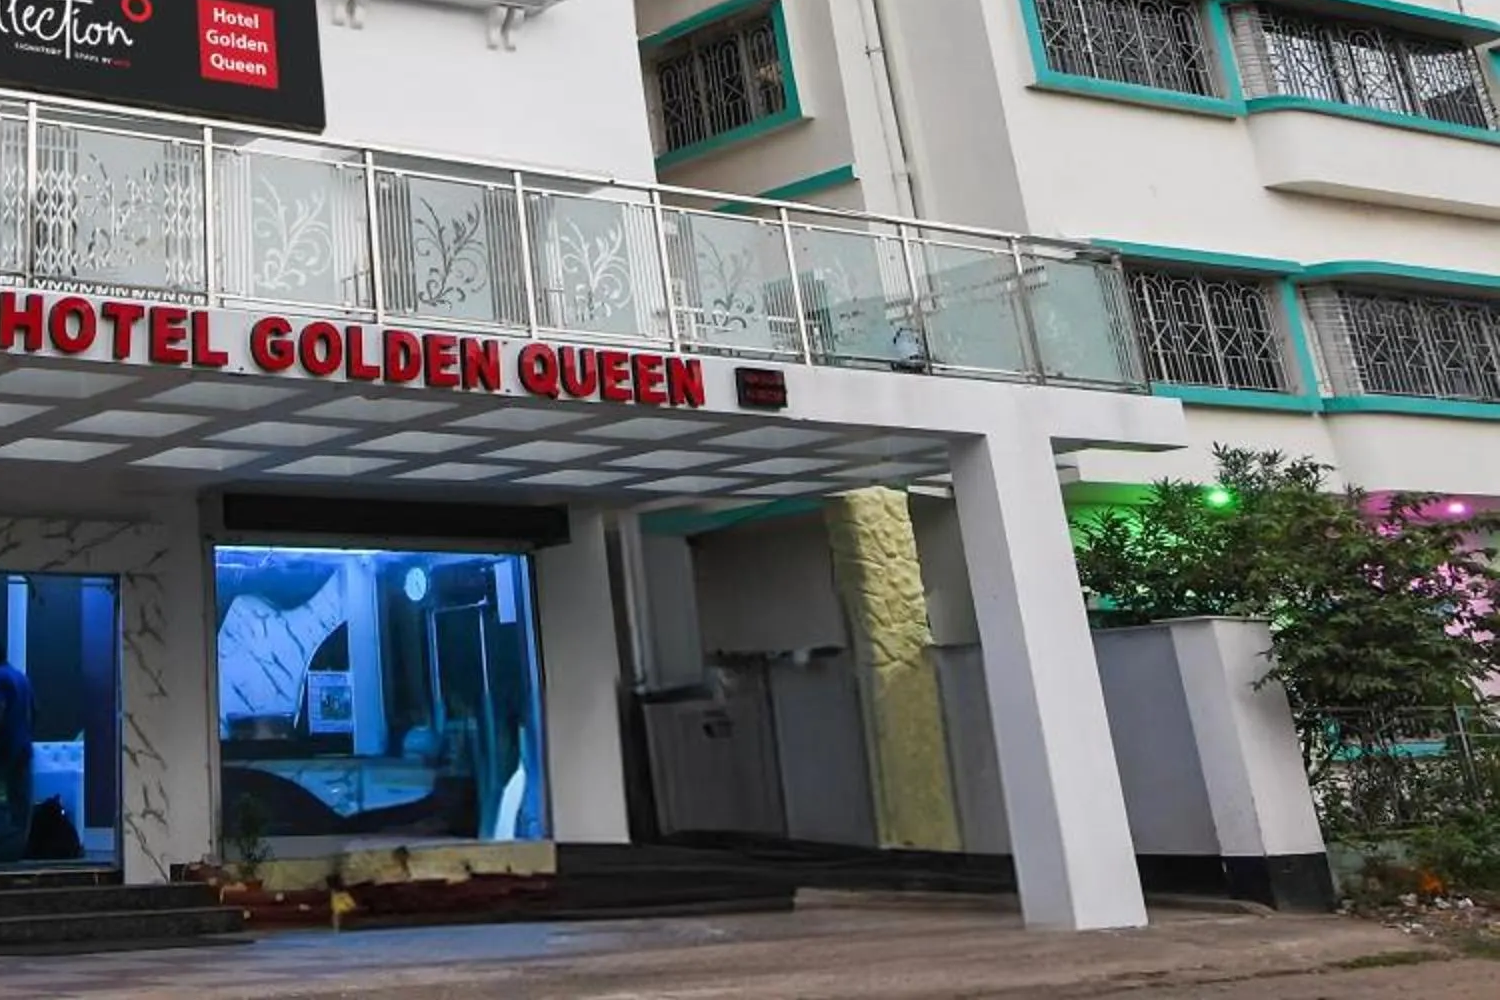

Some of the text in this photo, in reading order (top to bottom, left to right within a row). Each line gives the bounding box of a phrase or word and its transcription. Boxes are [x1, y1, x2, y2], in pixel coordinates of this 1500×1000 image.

[213, 8, 260, 30] Hotel
[206, 29, 269, 53] Golden
[210, 54, 267, 77] Queen
[250, 316, 502, 391] GOLDEN
[518, 343, 706, 407] QUEEN
